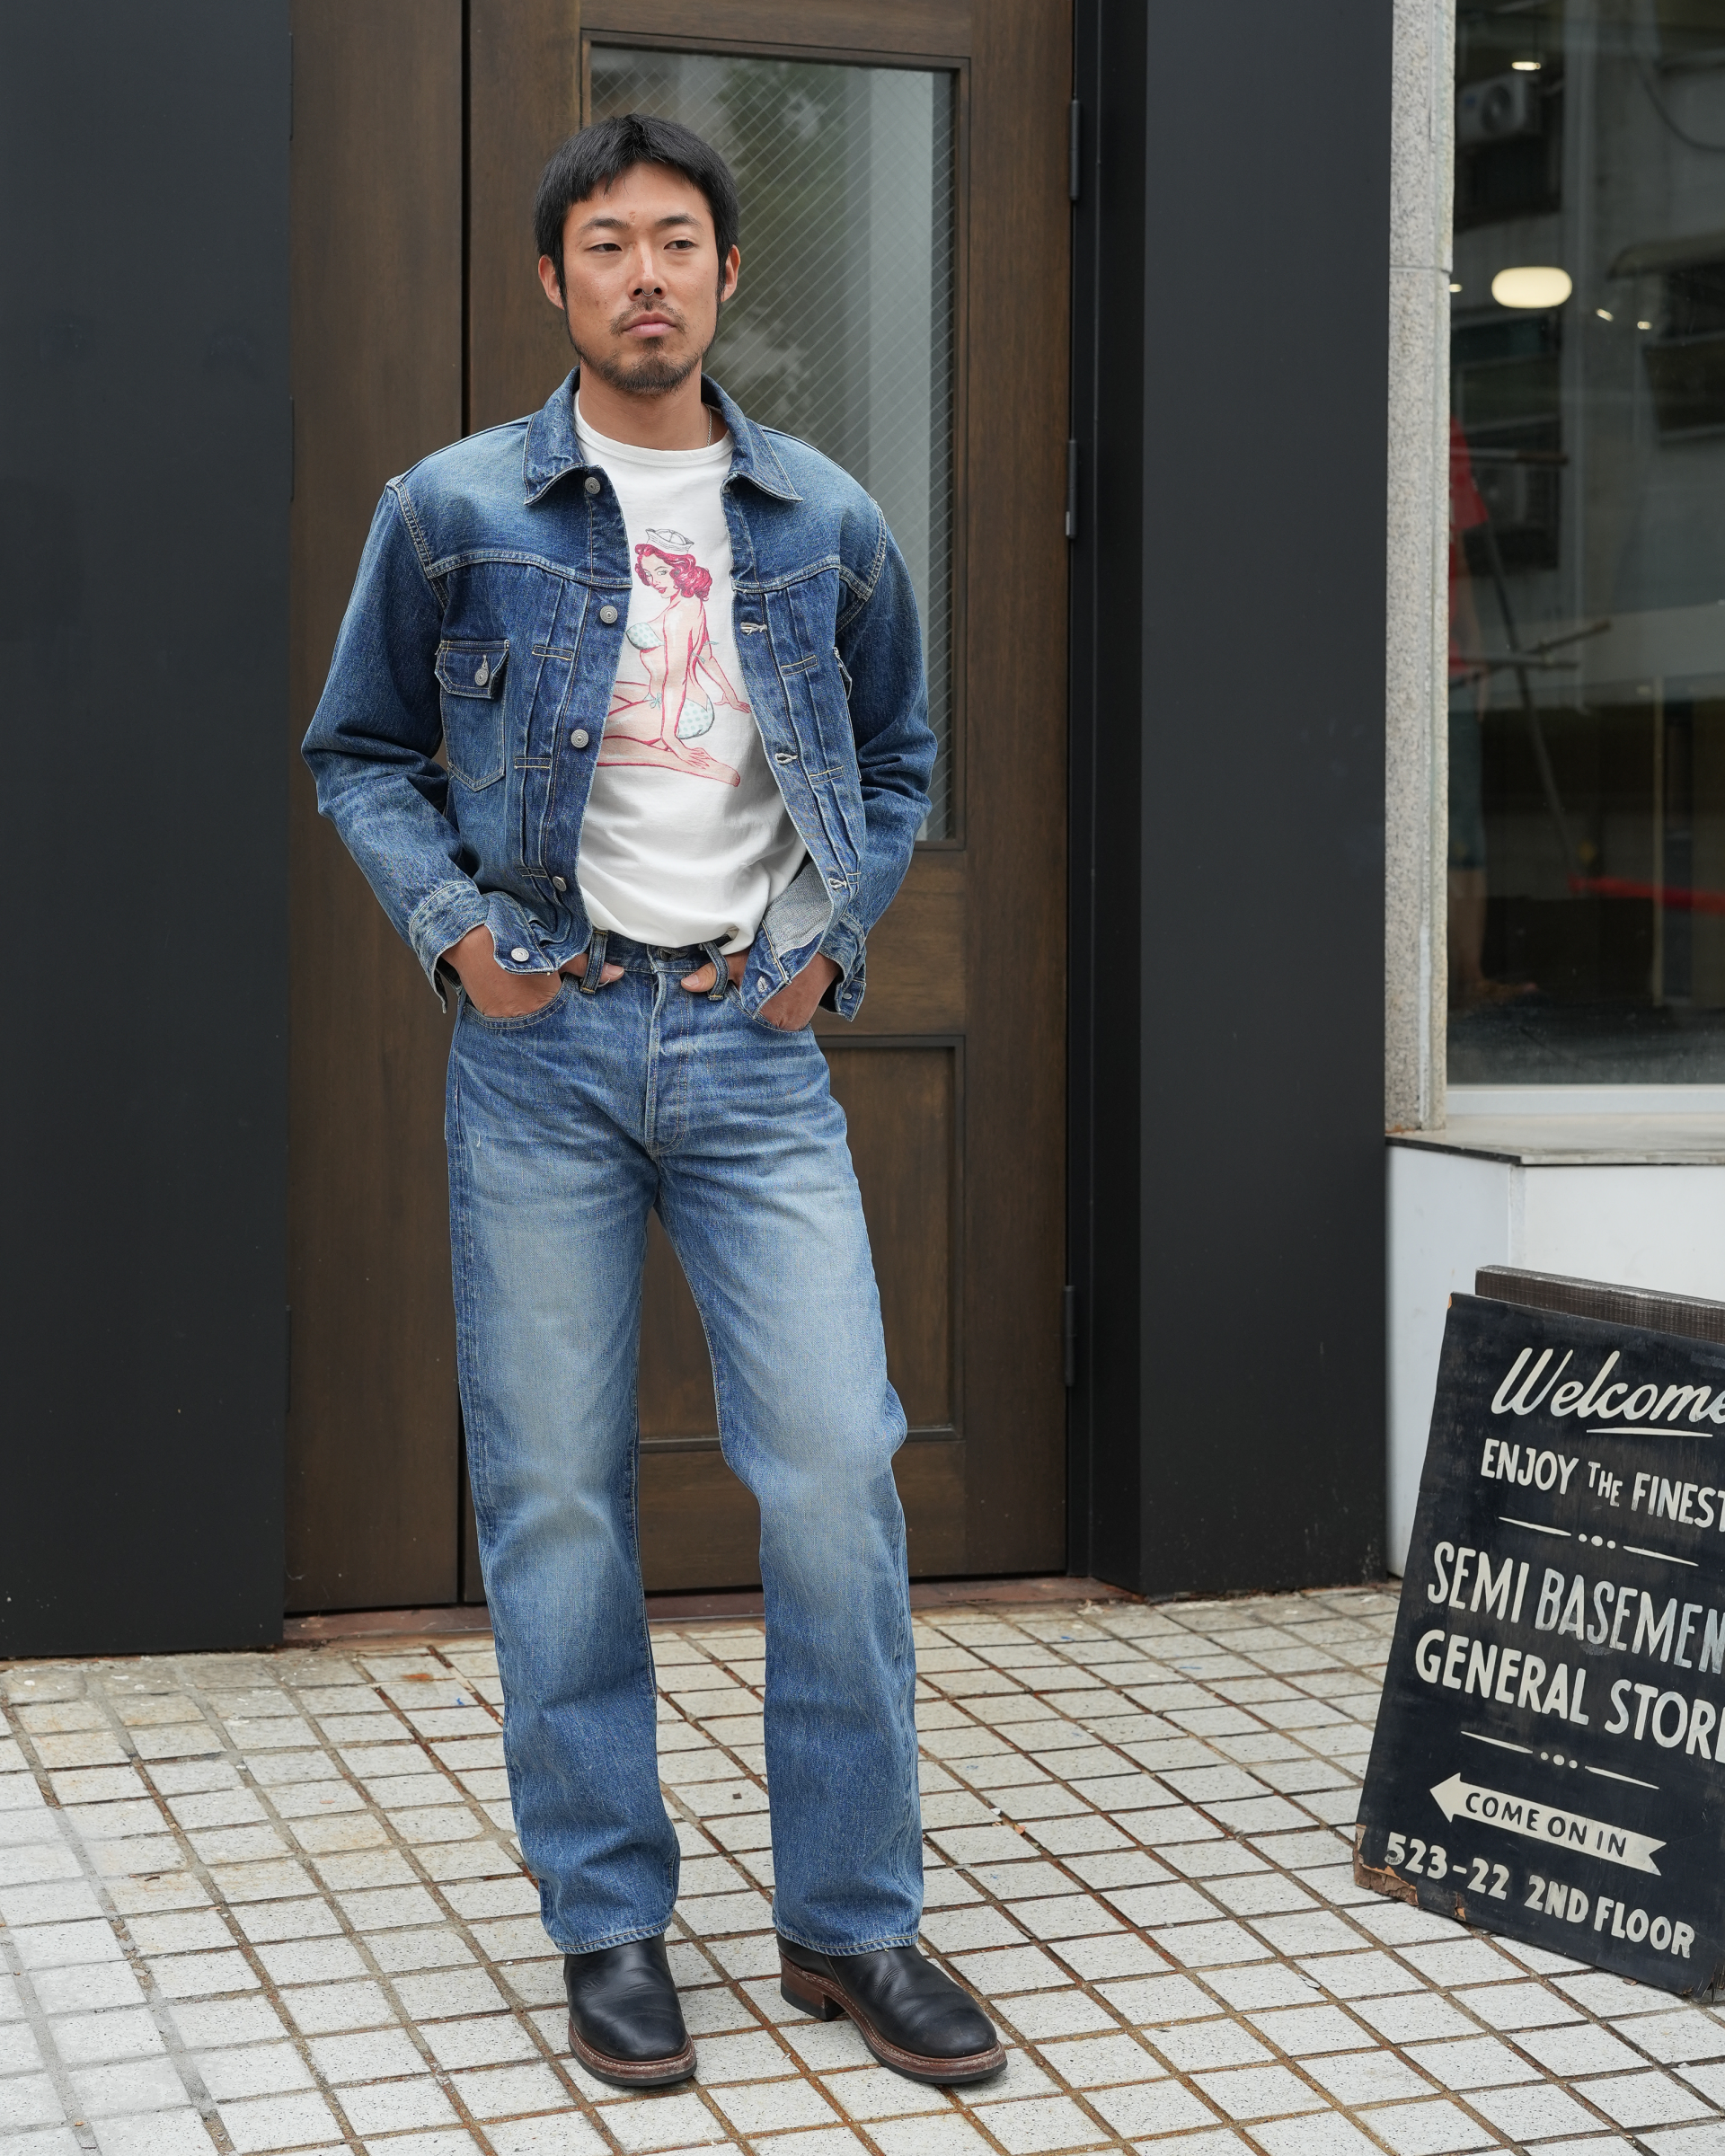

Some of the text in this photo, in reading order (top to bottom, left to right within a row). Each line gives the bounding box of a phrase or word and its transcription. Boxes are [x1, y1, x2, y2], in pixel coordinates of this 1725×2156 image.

[1481, 1438, 1579, 1494] ENJOY
[1588, 1461, 1623, 1507] THE
[1427, 1541, 1530, 1623] SEMI
[1415, 1629, 1589, 1726] GENERAL
[1465, 1792, 1627, 1857] COME ON IN
[1384, 1831, 1695, 1959] 523-22 2ND FLOOR
